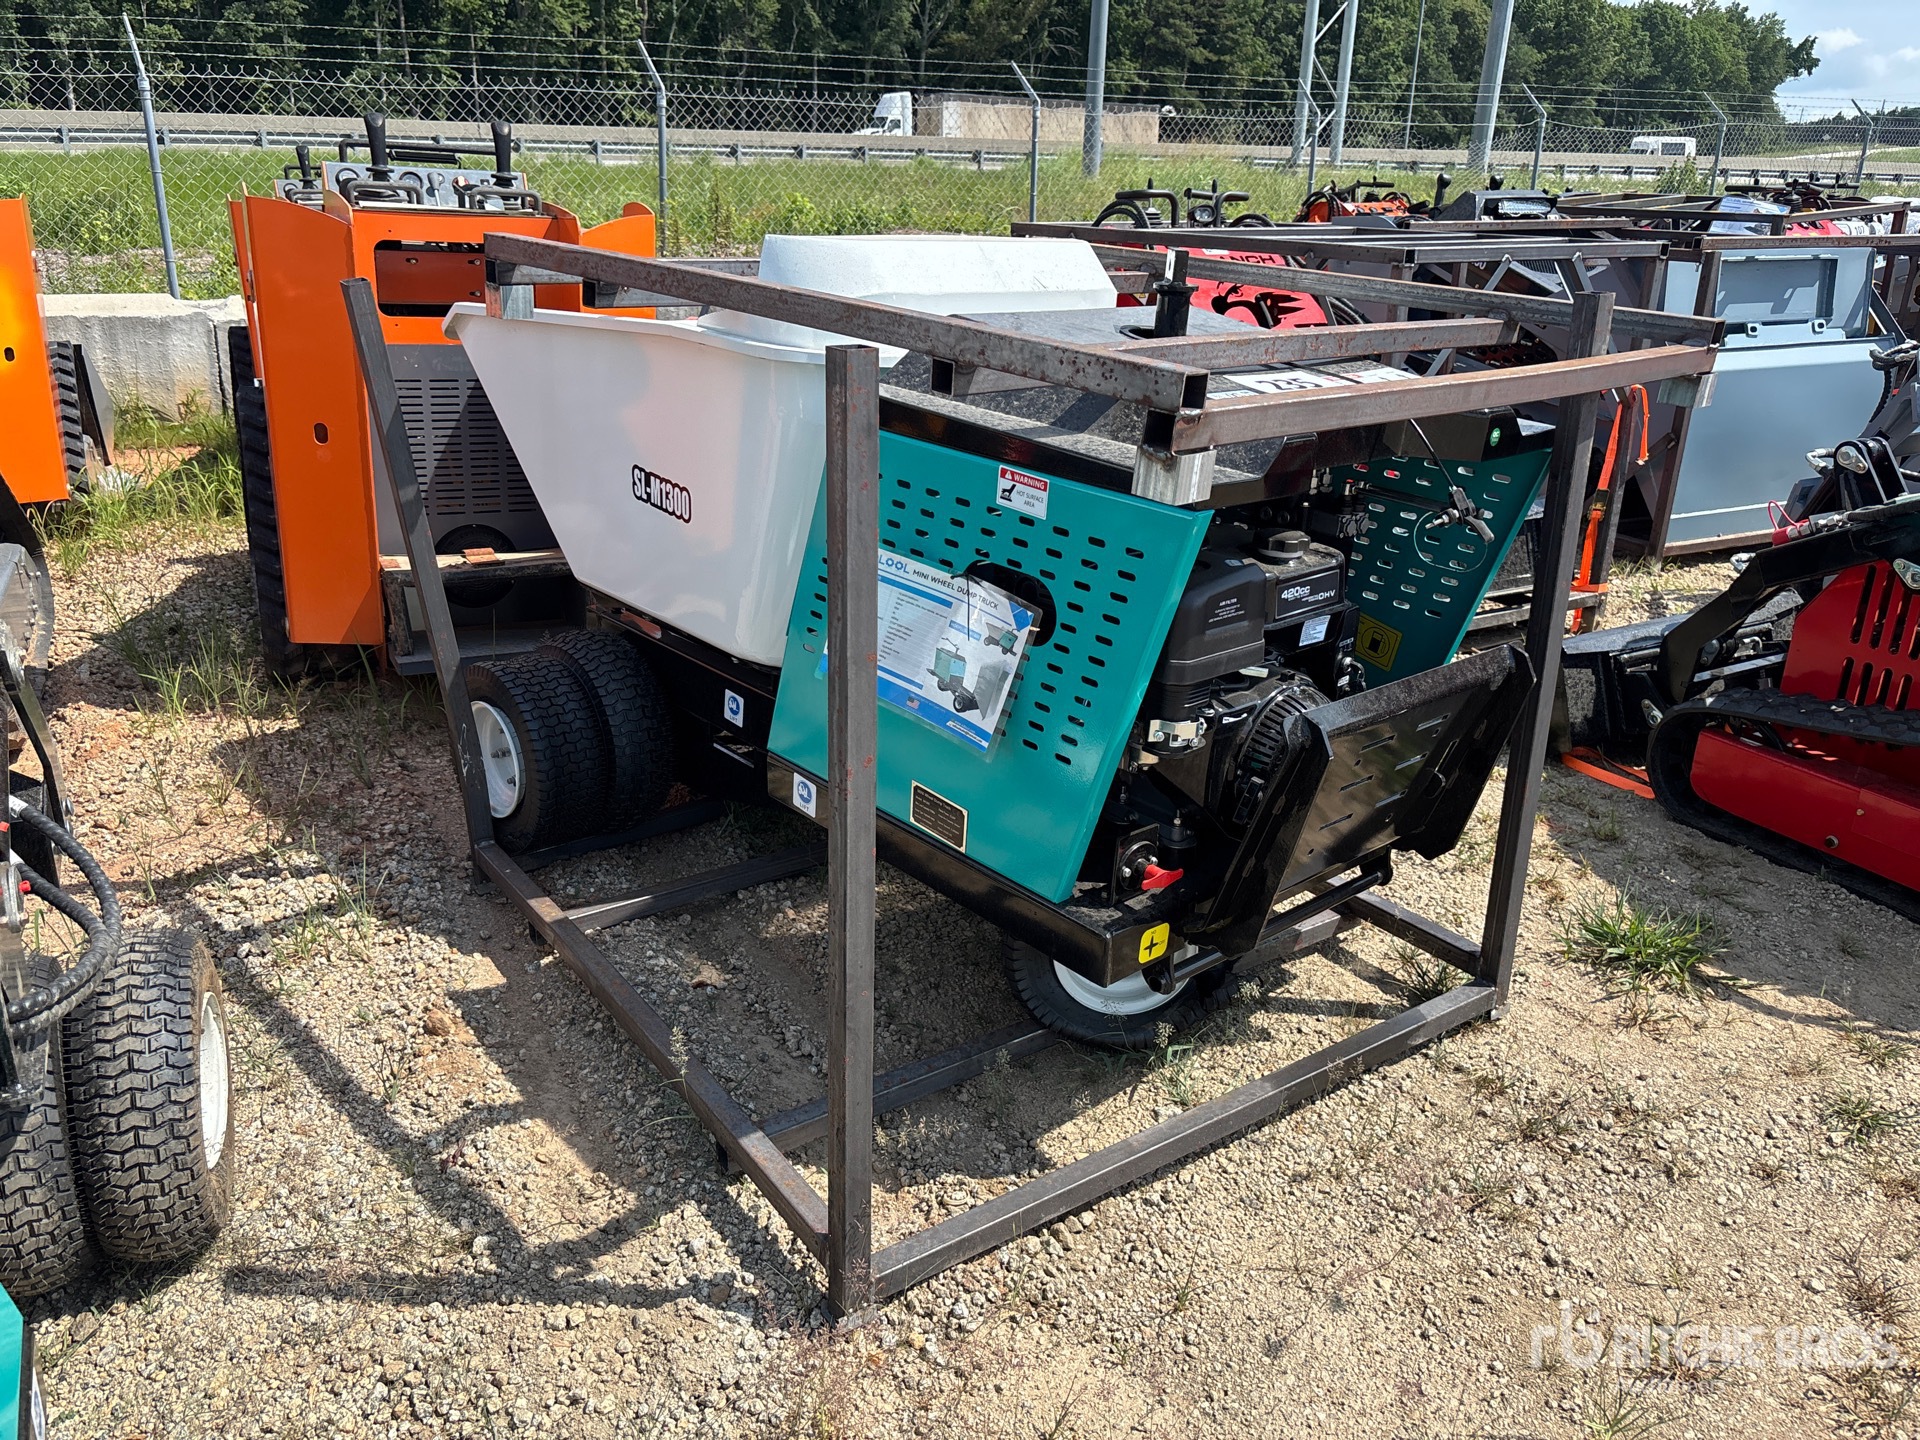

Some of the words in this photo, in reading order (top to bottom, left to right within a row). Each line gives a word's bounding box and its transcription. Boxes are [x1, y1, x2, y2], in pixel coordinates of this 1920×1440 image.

[1013, 473, 1045, 490] WARNING
[632, 464, 692, 524] SL-M1300
[1016, 489, 1026, 498] HOT
[1025, 492, 1044, 504] SURFACE
[1023, 499, 1036, 508] AREA
[912, 569, 930, 582] MINI
[930, 575, 956, 592] WHEEL
[956, 586, 978, 599] DUMP
[978, 594, 999, 611] TRUCK
[1281, 585, 1311, 600] 420cc
